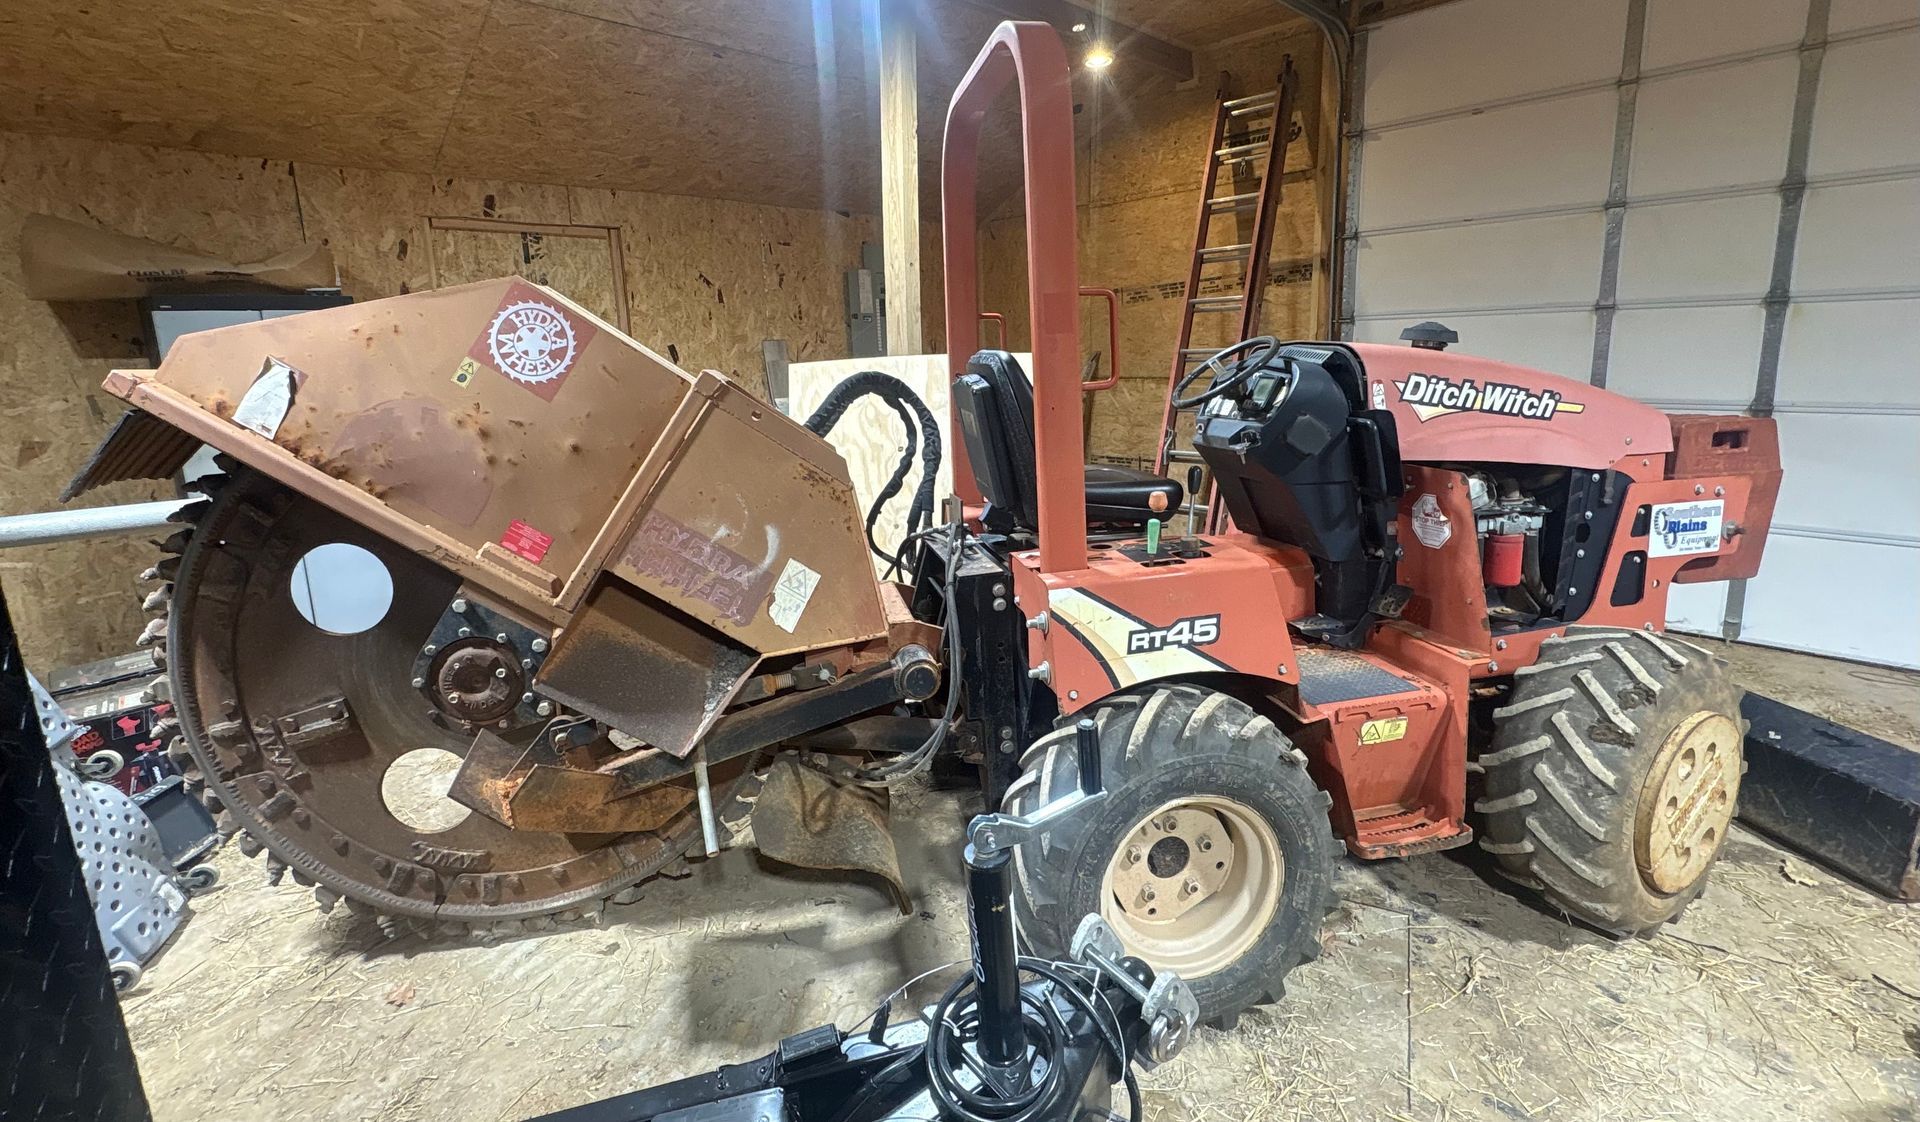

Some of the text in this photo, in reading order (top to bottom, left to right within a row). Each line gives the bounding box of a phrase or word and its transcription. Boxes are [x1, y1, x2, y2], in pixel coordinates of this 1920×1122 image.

[508, 309, 568, 351] HYDRA
[497, 332, 562, 376] WHEEL
[1402, 373, 1557, 418] Ditch Witch
[1667, 518, 1708, 534] Plains
[1130, 617, 1218, 651] RT45
